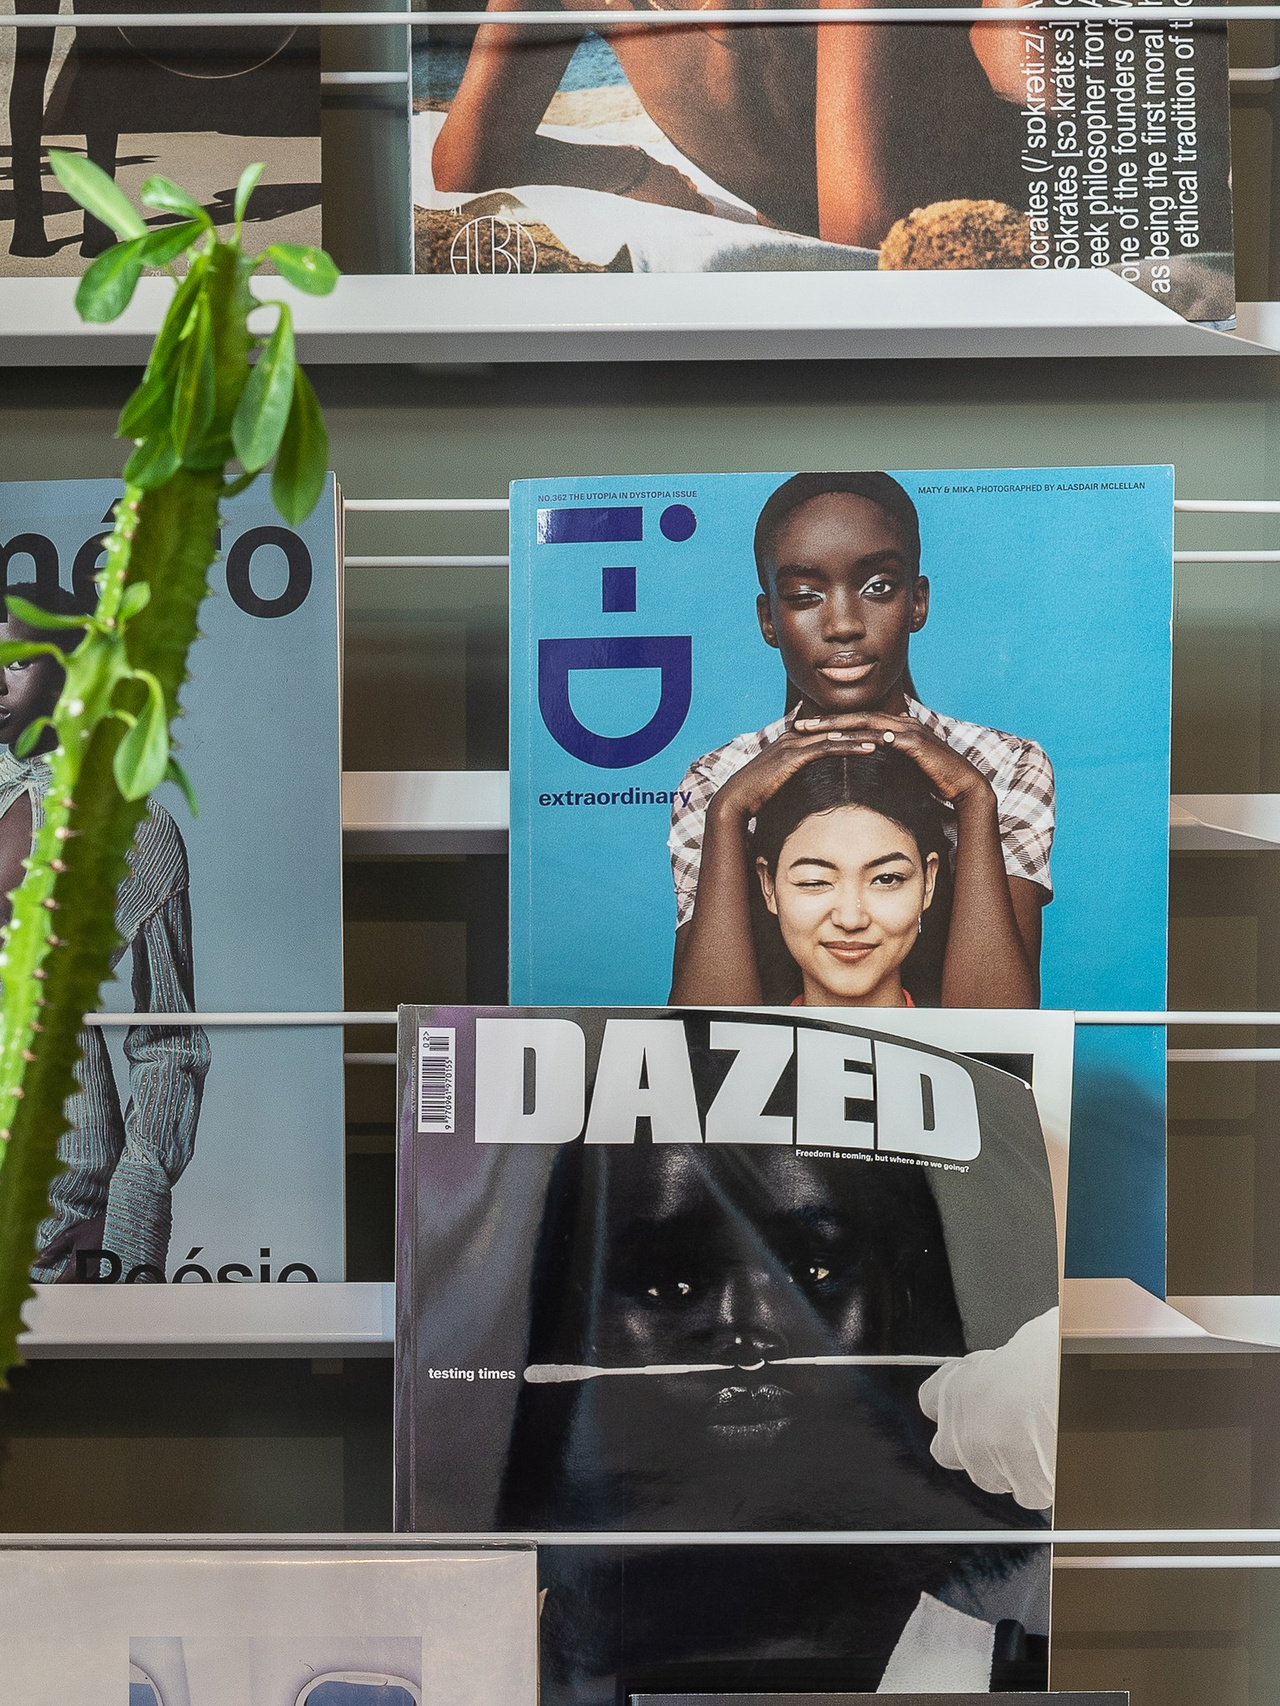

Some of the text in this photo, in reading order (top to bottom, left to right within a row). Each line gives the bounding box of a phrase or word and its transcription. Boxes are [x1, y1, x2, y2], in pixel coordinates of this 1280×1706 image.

[1081, 75, 1115, 215] philosopher
[1108, 19, 1141, 282] one of the founders of
[1138, 29, 1175, 293] as being the first moral
[1169, 35, 1199, 247] ethical tradition of
[1025, 180, 1049, 269] ocrates
[1083, 222, 1110, 269] eek
[538, 494, 567, 502] NO.362
[569, 493, 585, 501] THE
[629, 491, 671, 499] DYSTOPIA
[672, 490, 698, 498] ISSUE
[918, 486, 942, 494] MATY
[952, 485, 974, 493] MIKA
[976, 484, 1043, 493] PHOTOGRAPHED
[1044, 484, 1055, 492] BY
[1056, 483, 1099, 491] ALASDAIR
[1101, 482, 1145, 490] MCLELLAN
[538, 785, 692, 808] extraordinary
[474, 1018, 982, 1161] DAZED
[795, 1149, 831, 1158] Freedom
[841, 1152, 874, 1162] coming,
[875, 1154, 888, 1162] but
[889, 1156, 915, 1165] where
[943, 1162, 970, 1173] going?
[428, 1367, 516, 1382] testing times
